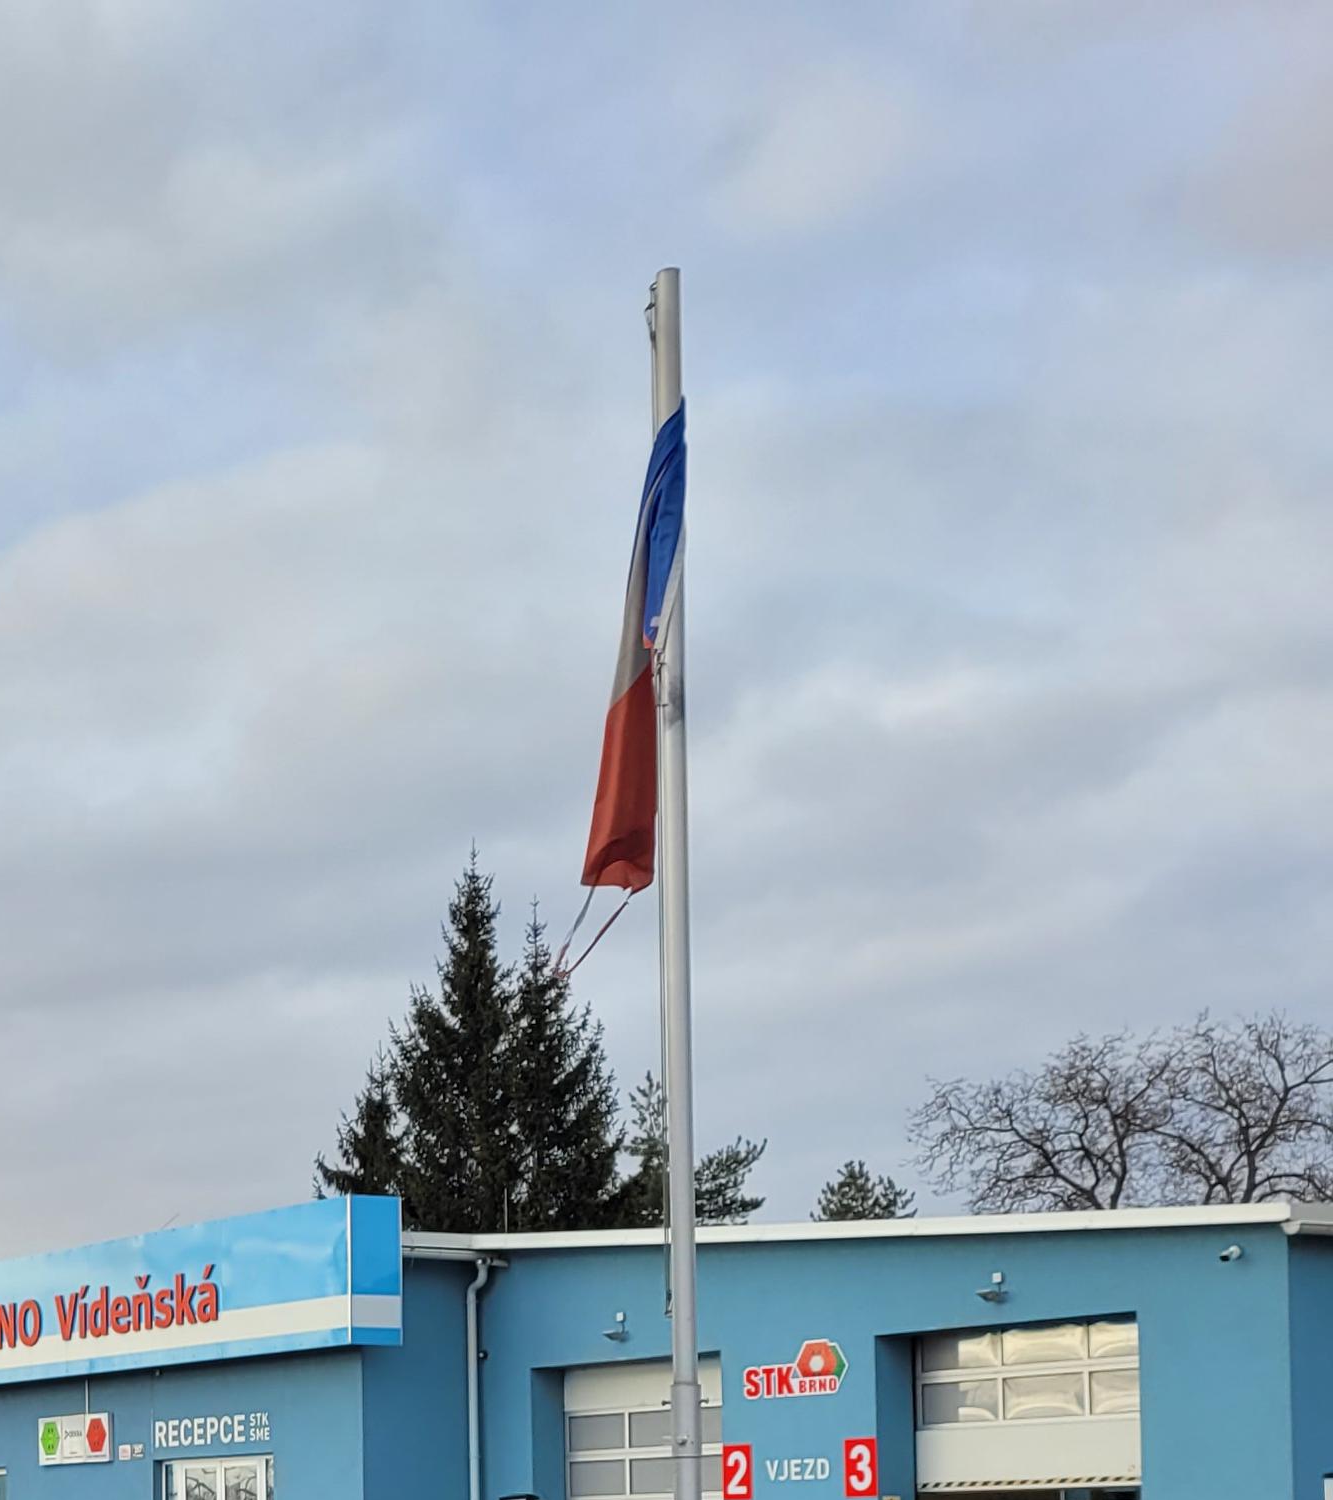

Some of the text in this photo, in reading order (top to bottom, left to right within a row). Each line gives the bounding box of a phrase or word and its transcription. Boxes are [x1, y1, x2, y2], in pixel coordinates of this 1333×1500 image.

[55, 1264, 218, 1341] Vídeňská
[745, 1366, 795, 1398] STK
[799, 1378, 837, 1393] BRNO
[155, 1414, 246, 1448] RECEPCE
[249, 1412, 269, 1426] STK
[249, 1427, 270, 1441] SME
[727, 1451, 748, 1495] 2
[766, 1458, 830, 1481] VJEZD
[849, 1444, 873, 1491] 3
